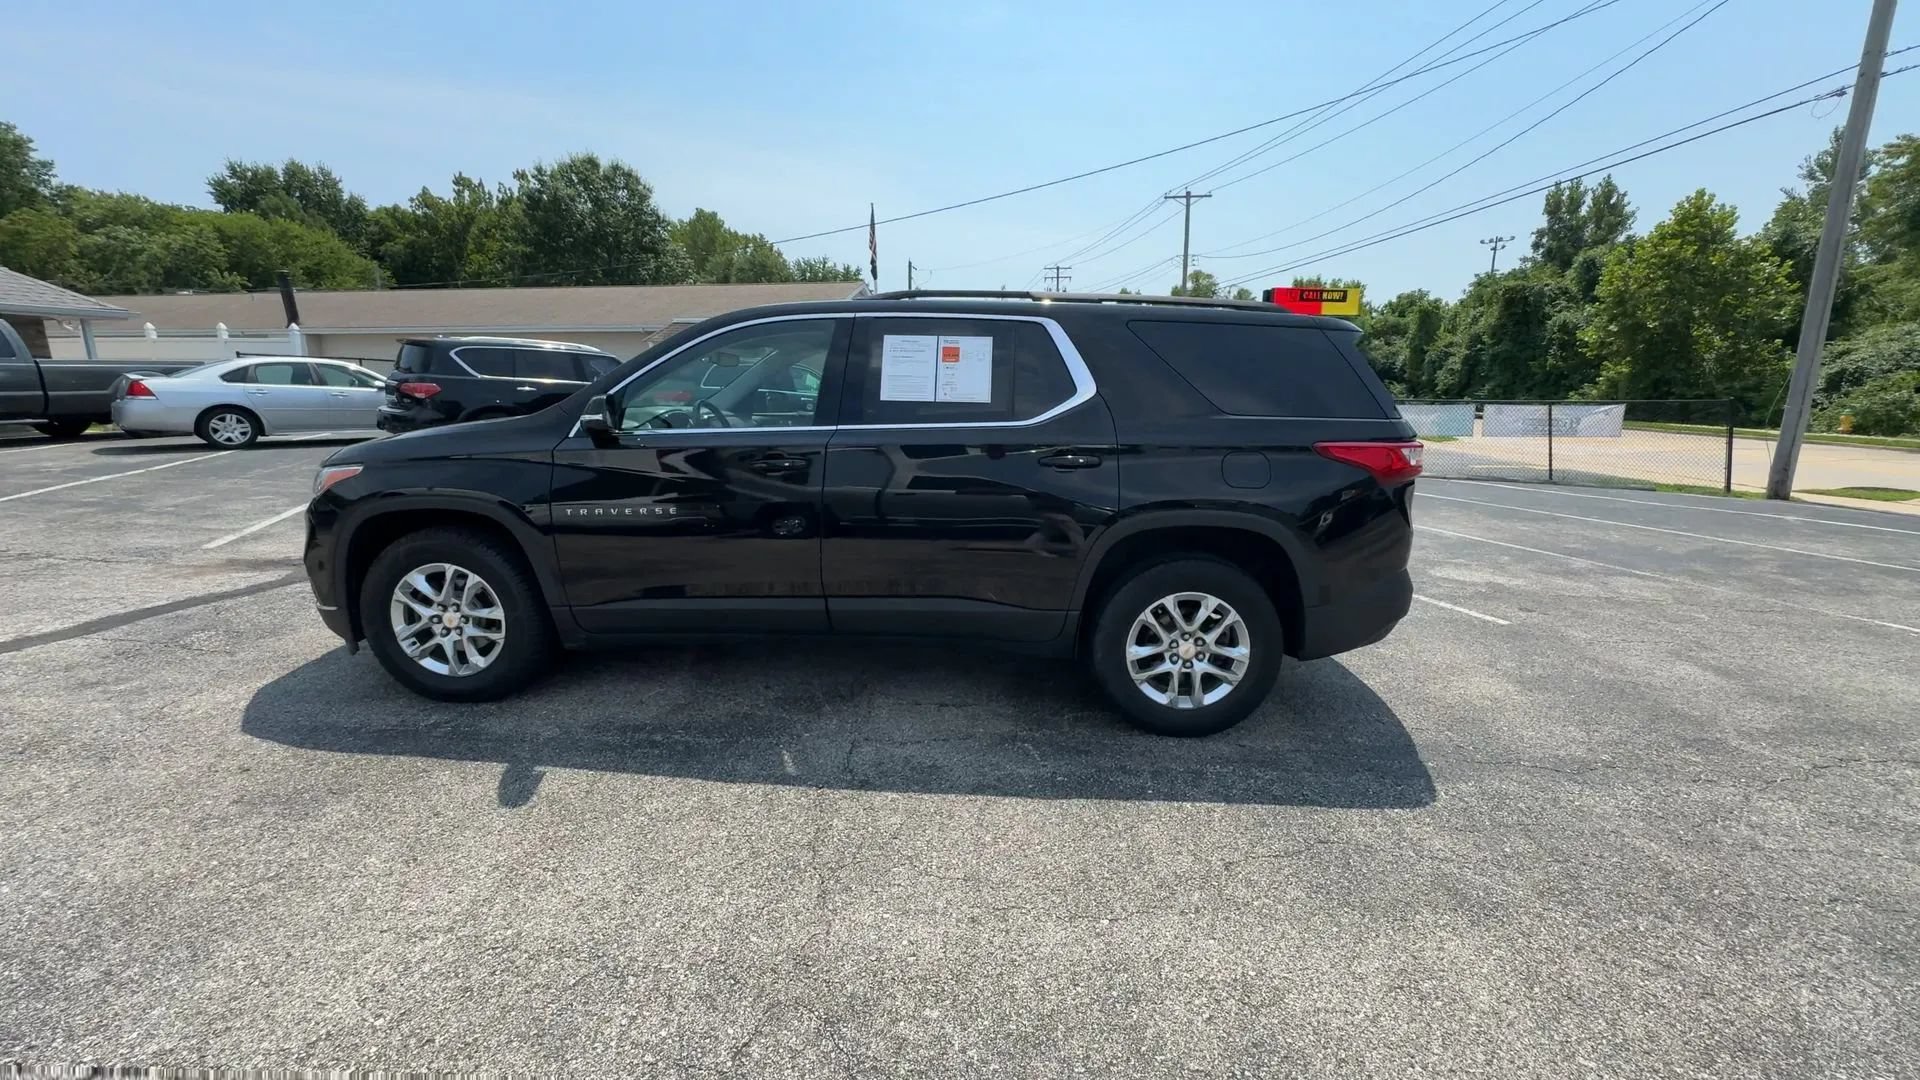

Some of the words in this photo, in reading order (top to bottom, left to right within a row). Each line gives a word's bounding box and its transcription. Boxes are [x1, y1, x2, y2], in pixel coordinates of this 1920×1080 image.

[1303, 291, 1320, 300] CALL
[1322, 291, 1344, 300] NOW!
[565, 507, 678, 516] TRAVERSE
